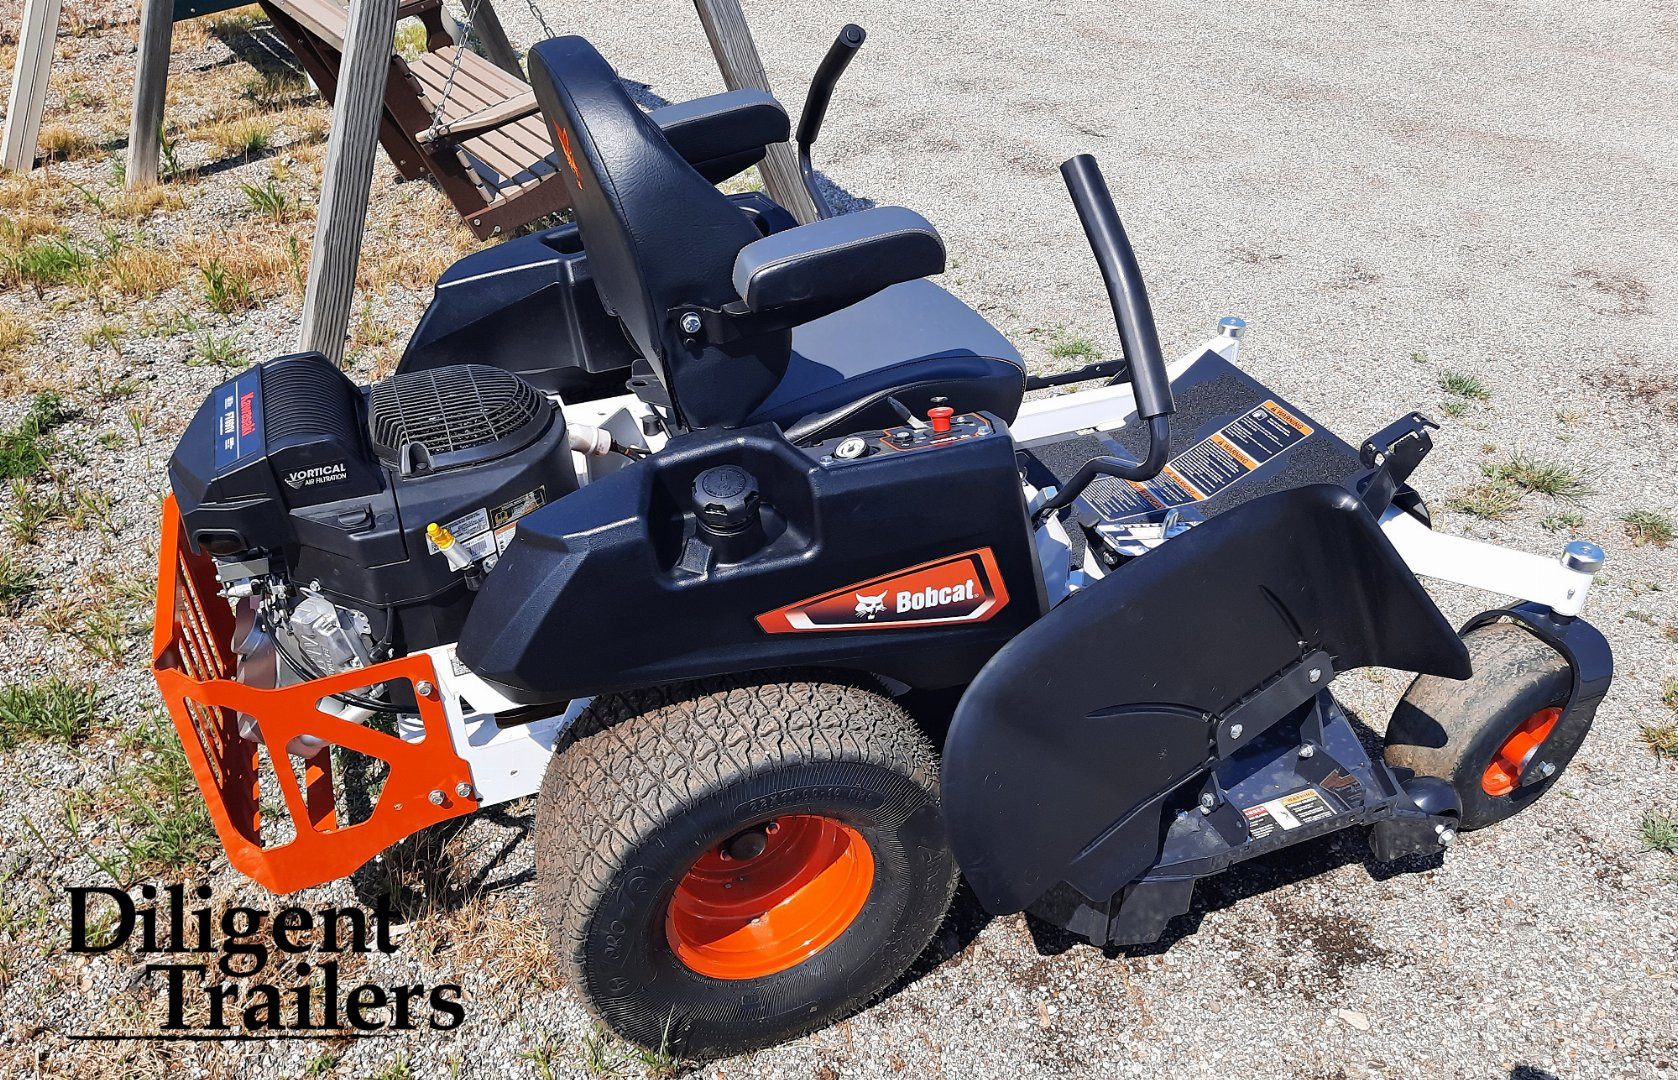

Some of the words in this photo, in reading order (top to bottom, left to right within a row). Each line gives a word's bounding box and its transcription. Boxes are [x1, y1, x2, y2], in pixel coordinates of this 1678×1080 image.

[241, 391, 256, 437] Kawasaki
[1277, 409, 1304, 430] WARNING
[1223, 443, 1249, 465] WARNING
[289, 463, 346, 481] VORTICAL
[316, 472, 347, 484] FILTRATION
[896, 579, 975, 613] Bobcat
